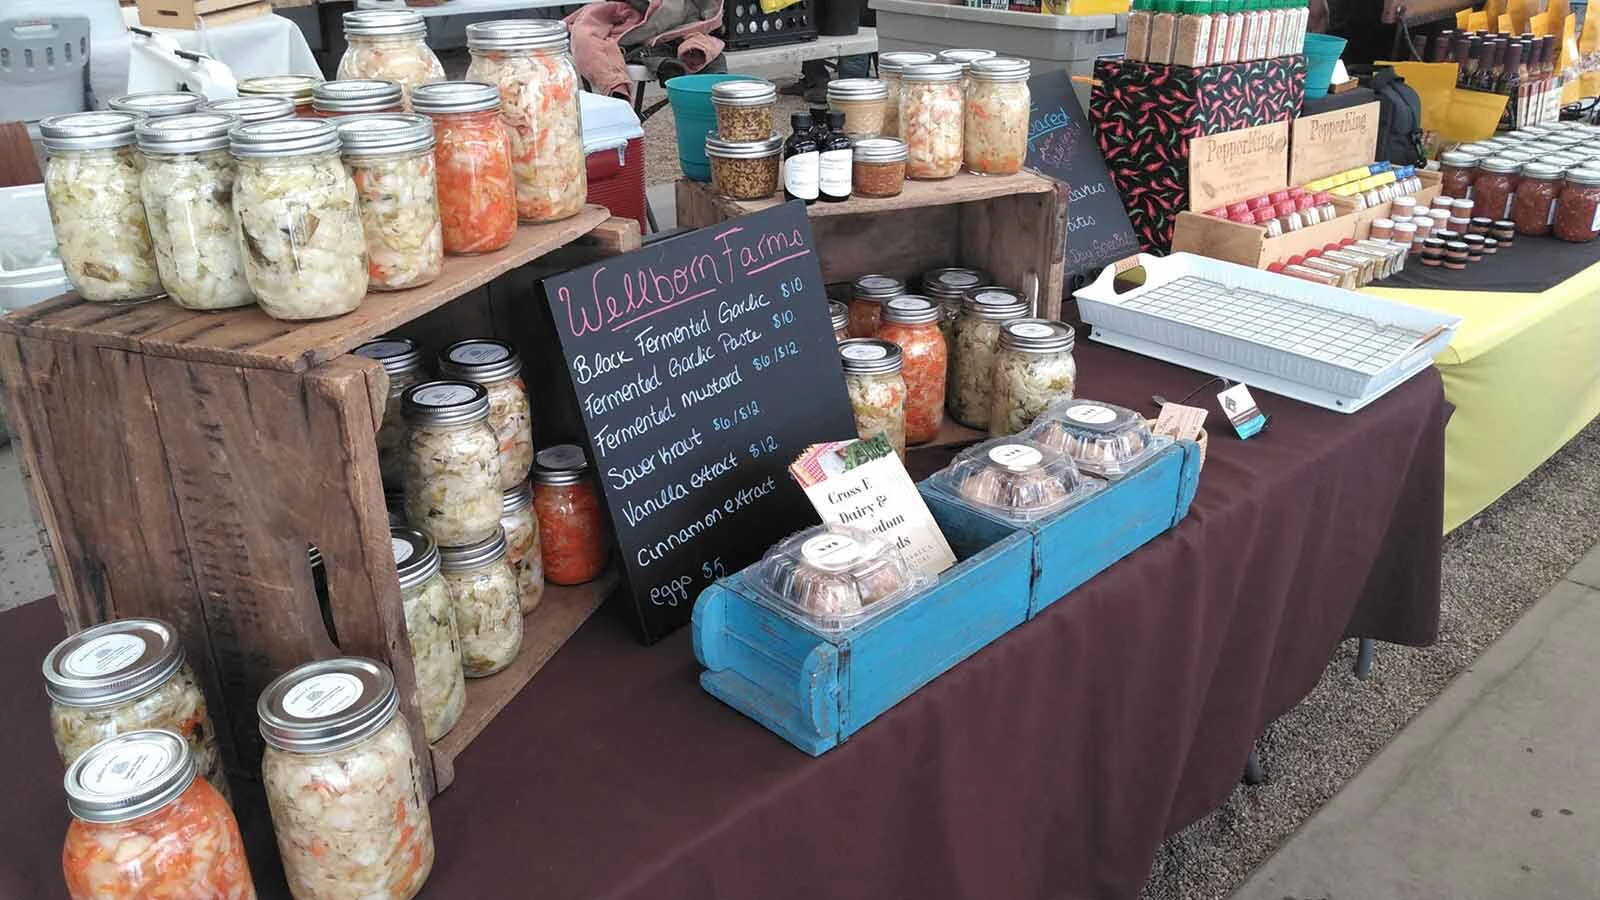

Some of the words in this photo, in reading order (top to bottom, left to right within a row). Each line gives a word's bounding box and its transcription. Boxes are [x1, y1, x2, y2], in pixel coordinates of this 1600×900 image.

[1207, 131, 1275, 162] PepperKing
[1309, 111, 1367, 140] PepperKing
[558, 254, 722, 337] Wellborn
[714, 227, 804, 284] Farms
[573, 350, 633, 385] Black
[634, 310, 711, 356] Fermented
[718, 291, 771, 325] Garlic
[584, 366, 663, 419] Fermented
[668, 344, 715, 378] Garlic
[721, 330, 762, 353] Paste
[594, 398, 677, 457] Fermented
[681, 364, 743, 409] mustard
[622, 484, 689, 528] Vanilla
[690, 451, 739, 488] extract
[749, 436, 778, 458] $12
[724, 476, 776, 513] extract
[827, 485, 863, 505] Cross
[839, 503, 875, 525] Dairy
[876, 495, 888, 508] &
[651, 574, 692, 607] eggs
[702, 556, 725, 580] $5
